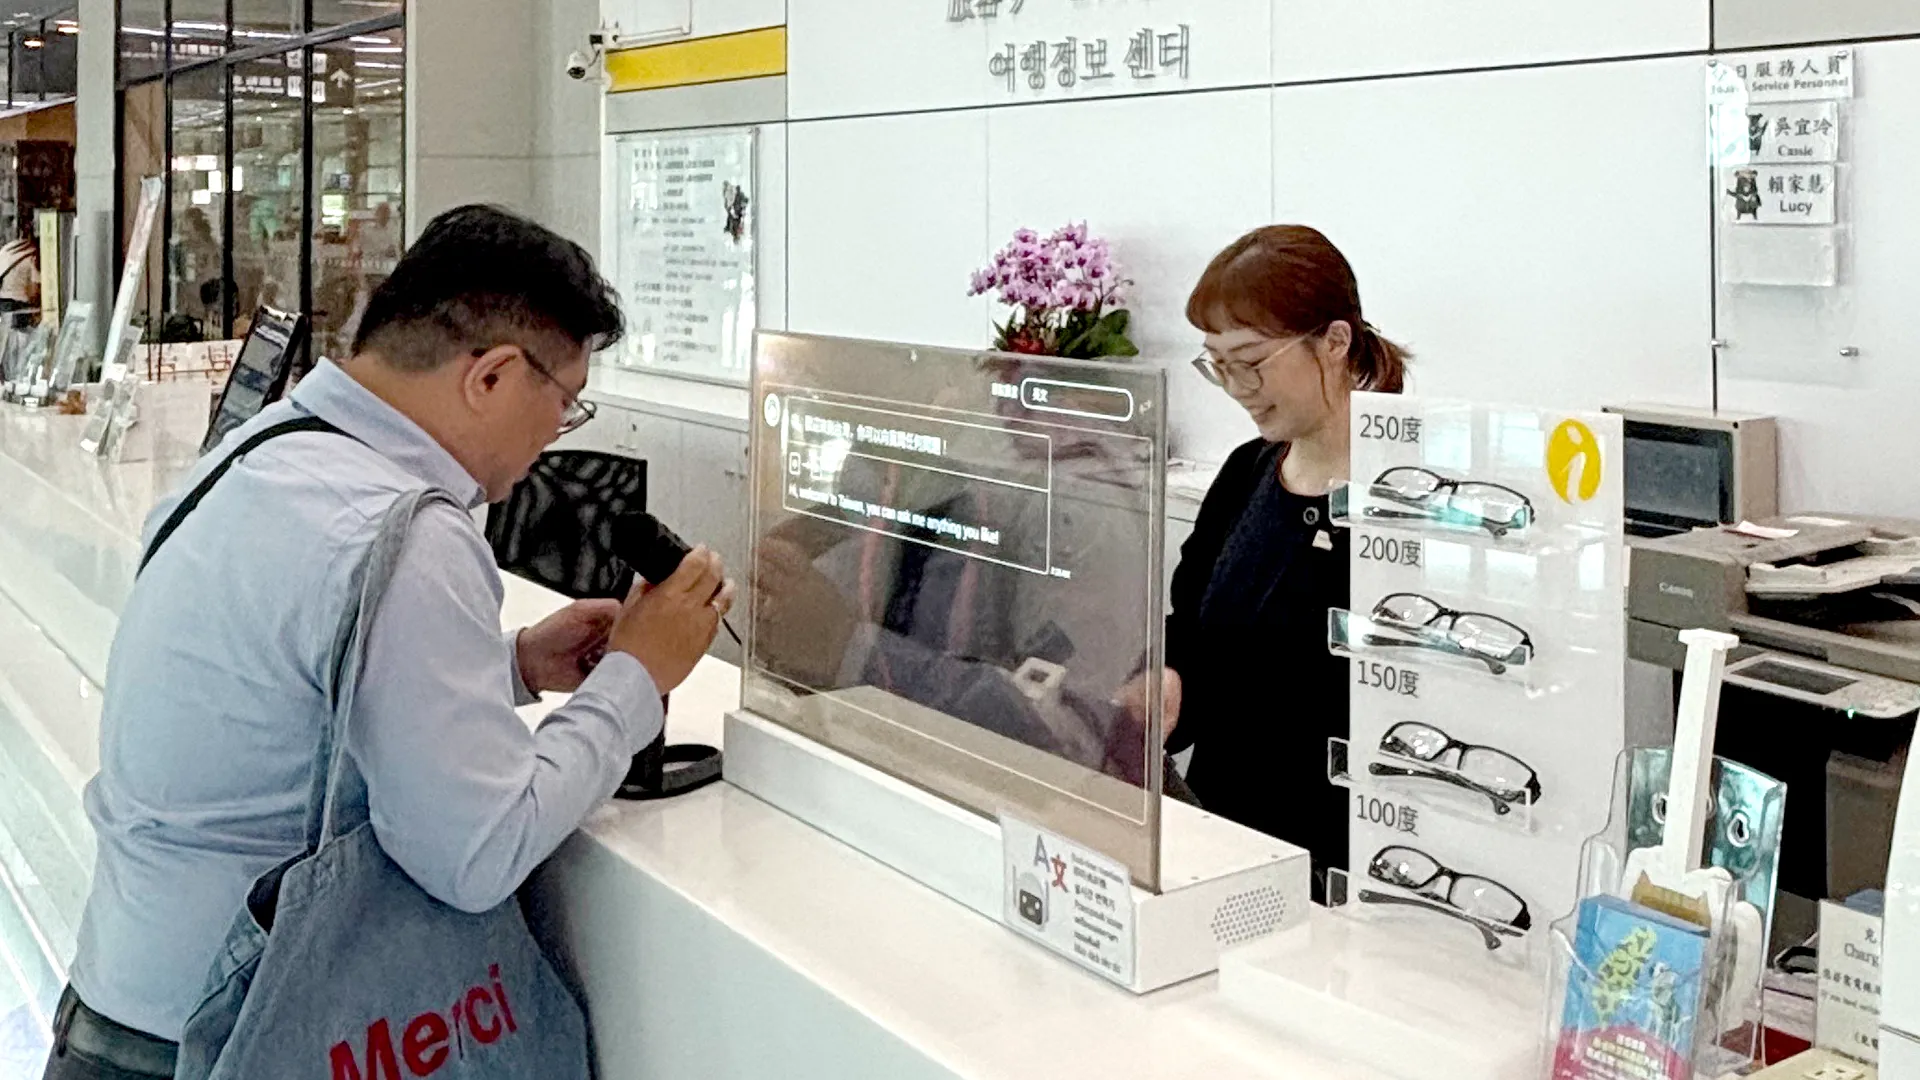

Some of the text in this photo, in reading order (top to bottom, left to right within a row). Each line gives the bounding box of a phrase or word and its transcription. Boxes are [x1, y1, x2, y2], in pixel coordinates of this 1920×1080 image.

[988, 24, 1190, 92] 여행정보 센터
[1751, 80, 1790, 92] Service
[1794, 76, 1849, 90] Personnel
[1777, 144, 1814, 157] Cassie
[1779, 199, 1813, 217] Lucy
[1359, 413, 1423, 444] 250度
[866, 502, 881, 518] you
[881, 506, 896, 520] can
[896, 508, 912, 524] ask
[912, 513, 926, 528] me
[926, 517, 963, 540] anything
[963, 524, 980, 542] you
[1358, 534, 1422, 569] 200度
[1357, 660, 1420, 699] 150度
[1356, 794, 1420, 838] 100度
[329, 962, 518, 1080] Merci
